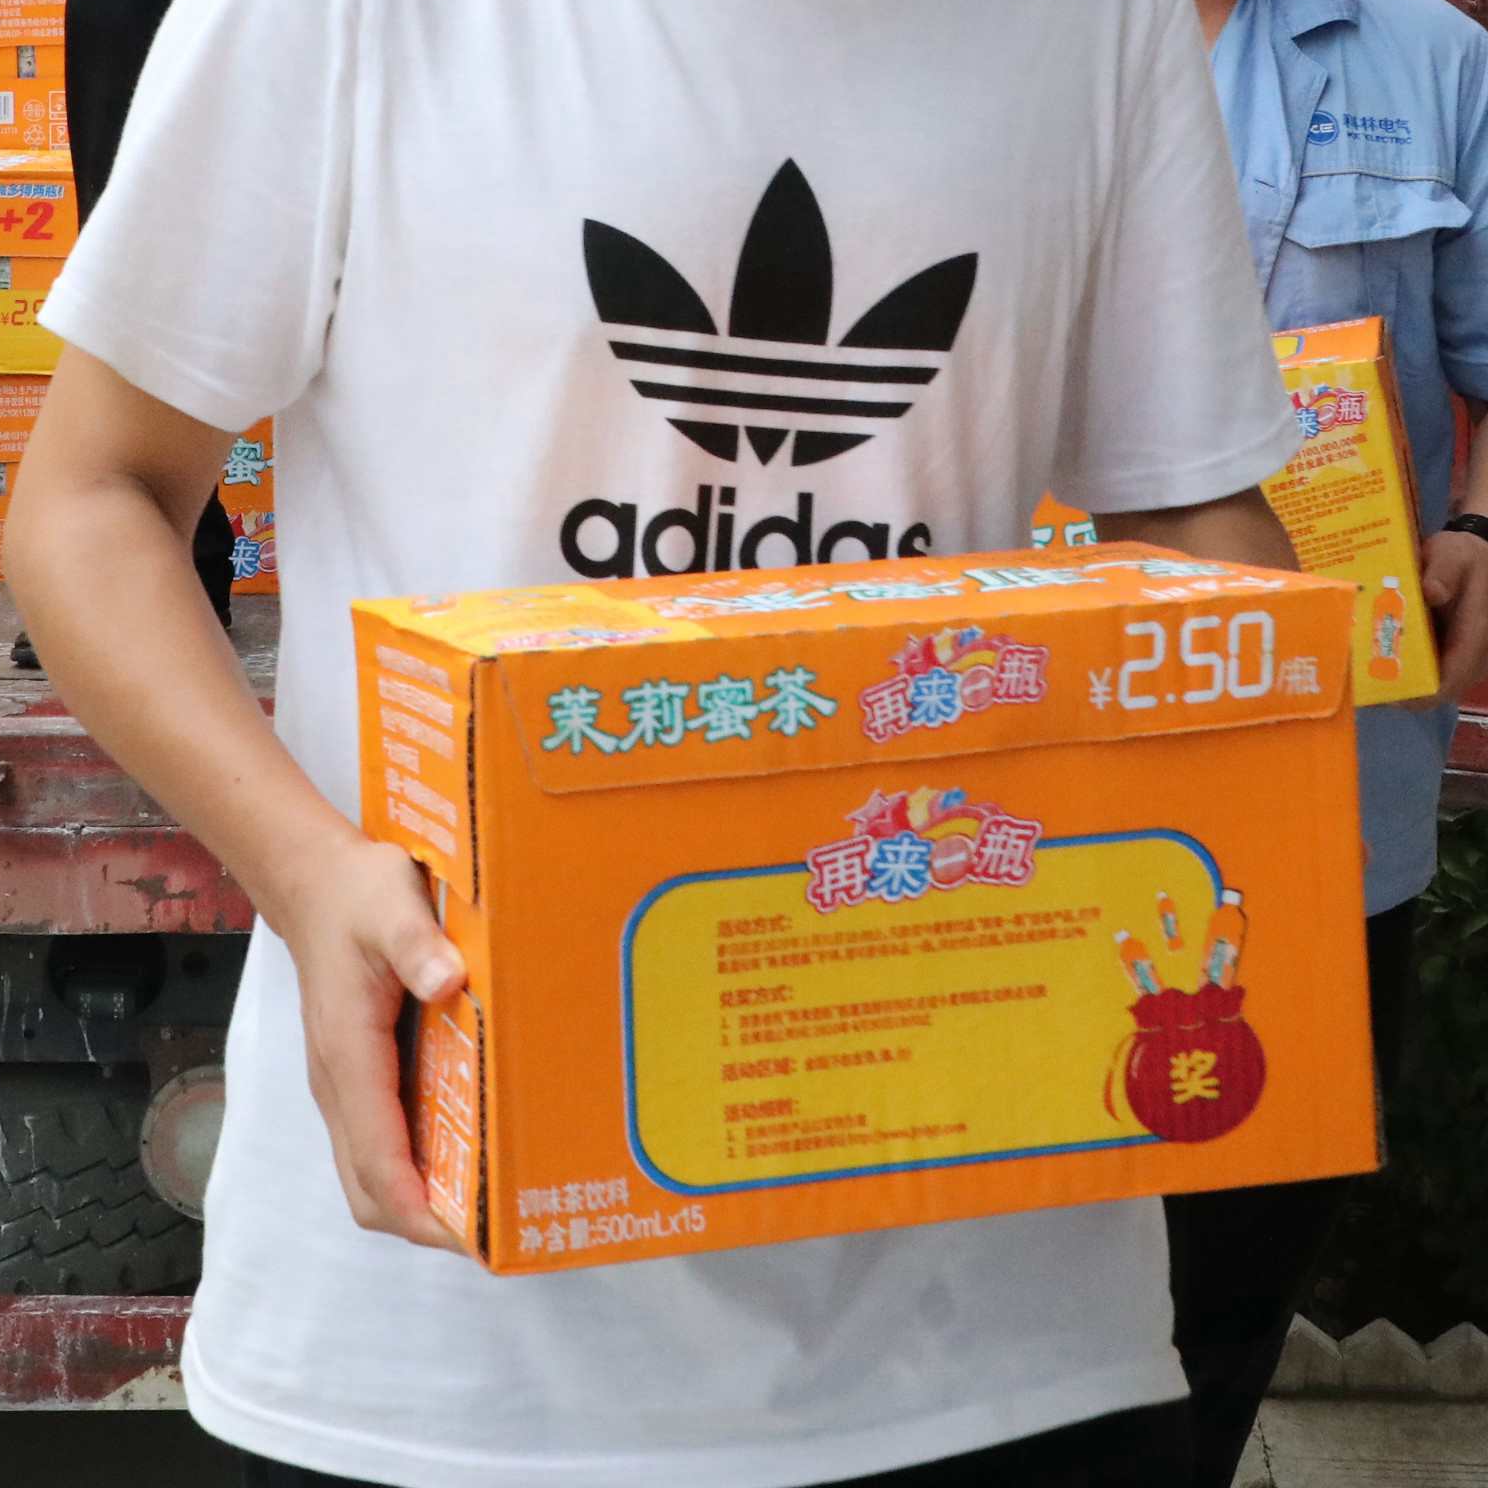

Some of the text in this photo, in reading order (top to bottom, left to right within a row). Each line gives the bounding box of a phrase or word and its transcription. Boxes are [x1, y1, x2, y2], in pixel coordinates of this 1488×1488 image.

[1295, 392, 1366, 438] 来一瓶
[560, 484, 932, 578] adidas
[859, 641, 1049, 744] 再来一瓶
[1088, 611, 1319, 711] ¥2.50/瓶
[542, 665, 836, 755] 茉莉蜜茶
[808, 814, 1042, 913] 再来一瓶
[1169, 1049, 1219, 1105] 奖
[518, 1178, 629, 1218] 调味茶饮料
